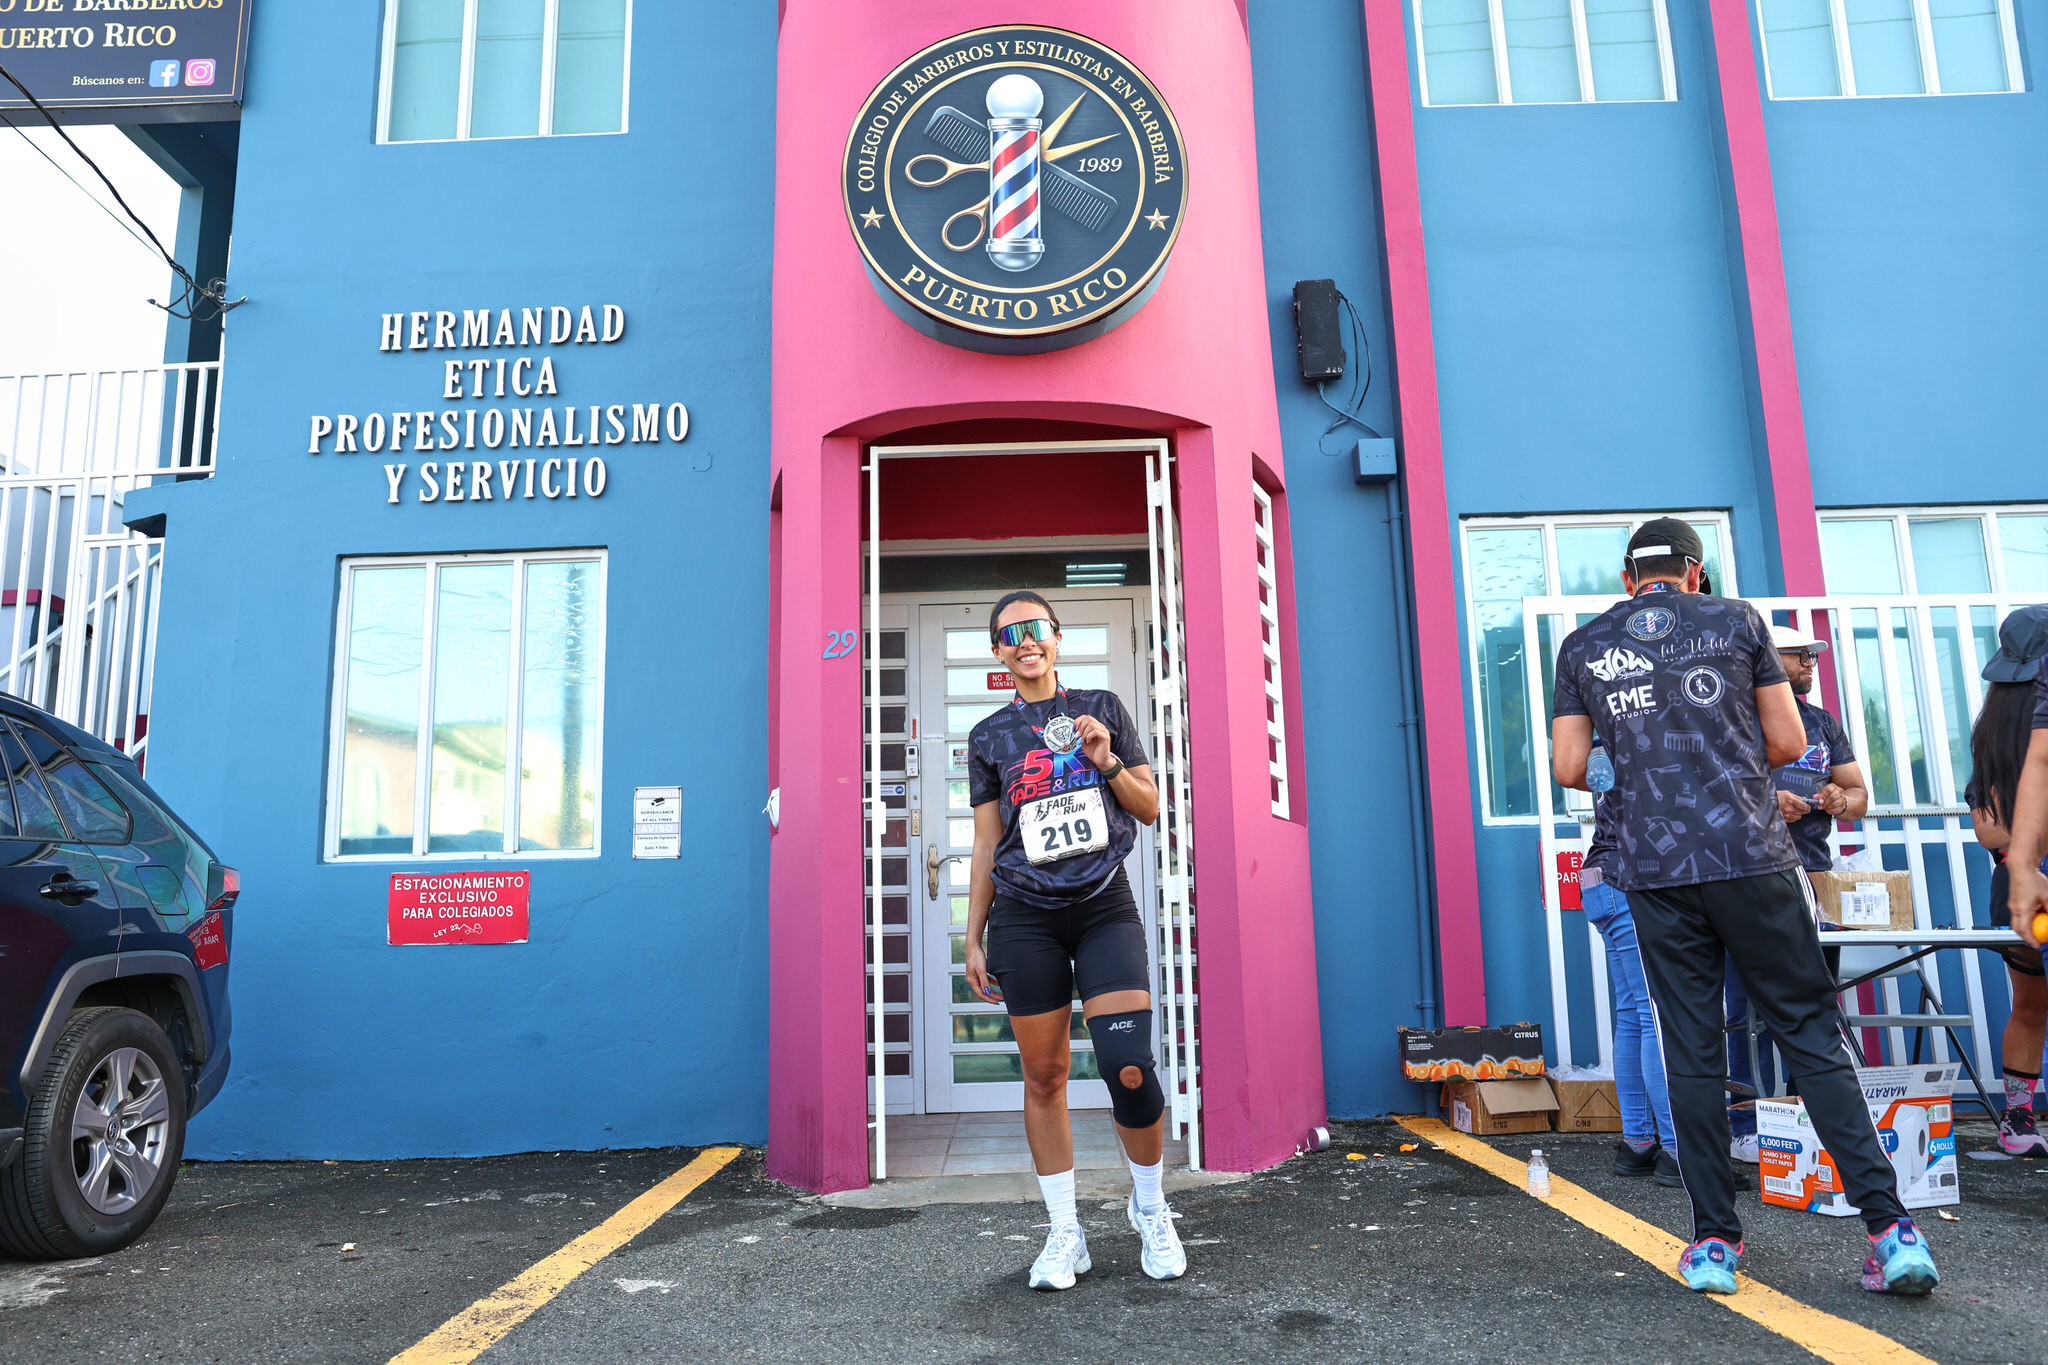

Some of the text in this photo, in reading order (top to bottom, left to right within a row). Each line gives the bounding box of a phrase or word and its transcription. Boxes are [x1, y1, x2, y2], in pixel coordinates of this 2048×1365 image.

[102, 23, 177, 47] RICO
[72, 76, 124, 86] Búscanos
[858, 40, 1174, 192] COLEGIO DE BARBEROS Y ESTILISTAS EN BARBERÍA
[1077, 157, 1123, 173] 1989
[900, 264, 1127, 320] PUERTO RICO
[380, 304, 626, 351] HERMANDAD
[443, 356, 558, 398] ETICA
[308, 402, 690, 454] PROFESIONALISMO
[384, 456, 606, 502] Y SERVICIO
[822, 630, 857, 660] 29
[1606, 684, 1656, 716] EME
[1616, 709, 1650, 720] STUDIO
[1052, 779, 1065, 792] &
[1046, 795, 1074, 810] FADE
[1063, 802, 1086, 815] RUN
[1041, 818, 1092, 852] 219
[394, 876, 524, 890] ESTACIONAMIENTO
[1556, 872, 1580, 883] PAR
[420, 891, 498, 903] EXCLUSIVO
[403, 906, 514, 919] PARA COLEGIADOS
[433, 924, 460, 938] LEY 22
[1109, 1020, 1134, 1031] ACE
[1759, 1106, 1795, 1115] MARATHON
[1761, 1137, 1780, 1147] 6,000
[1930, 1141, 1954, 1154] 6 ROLLS
